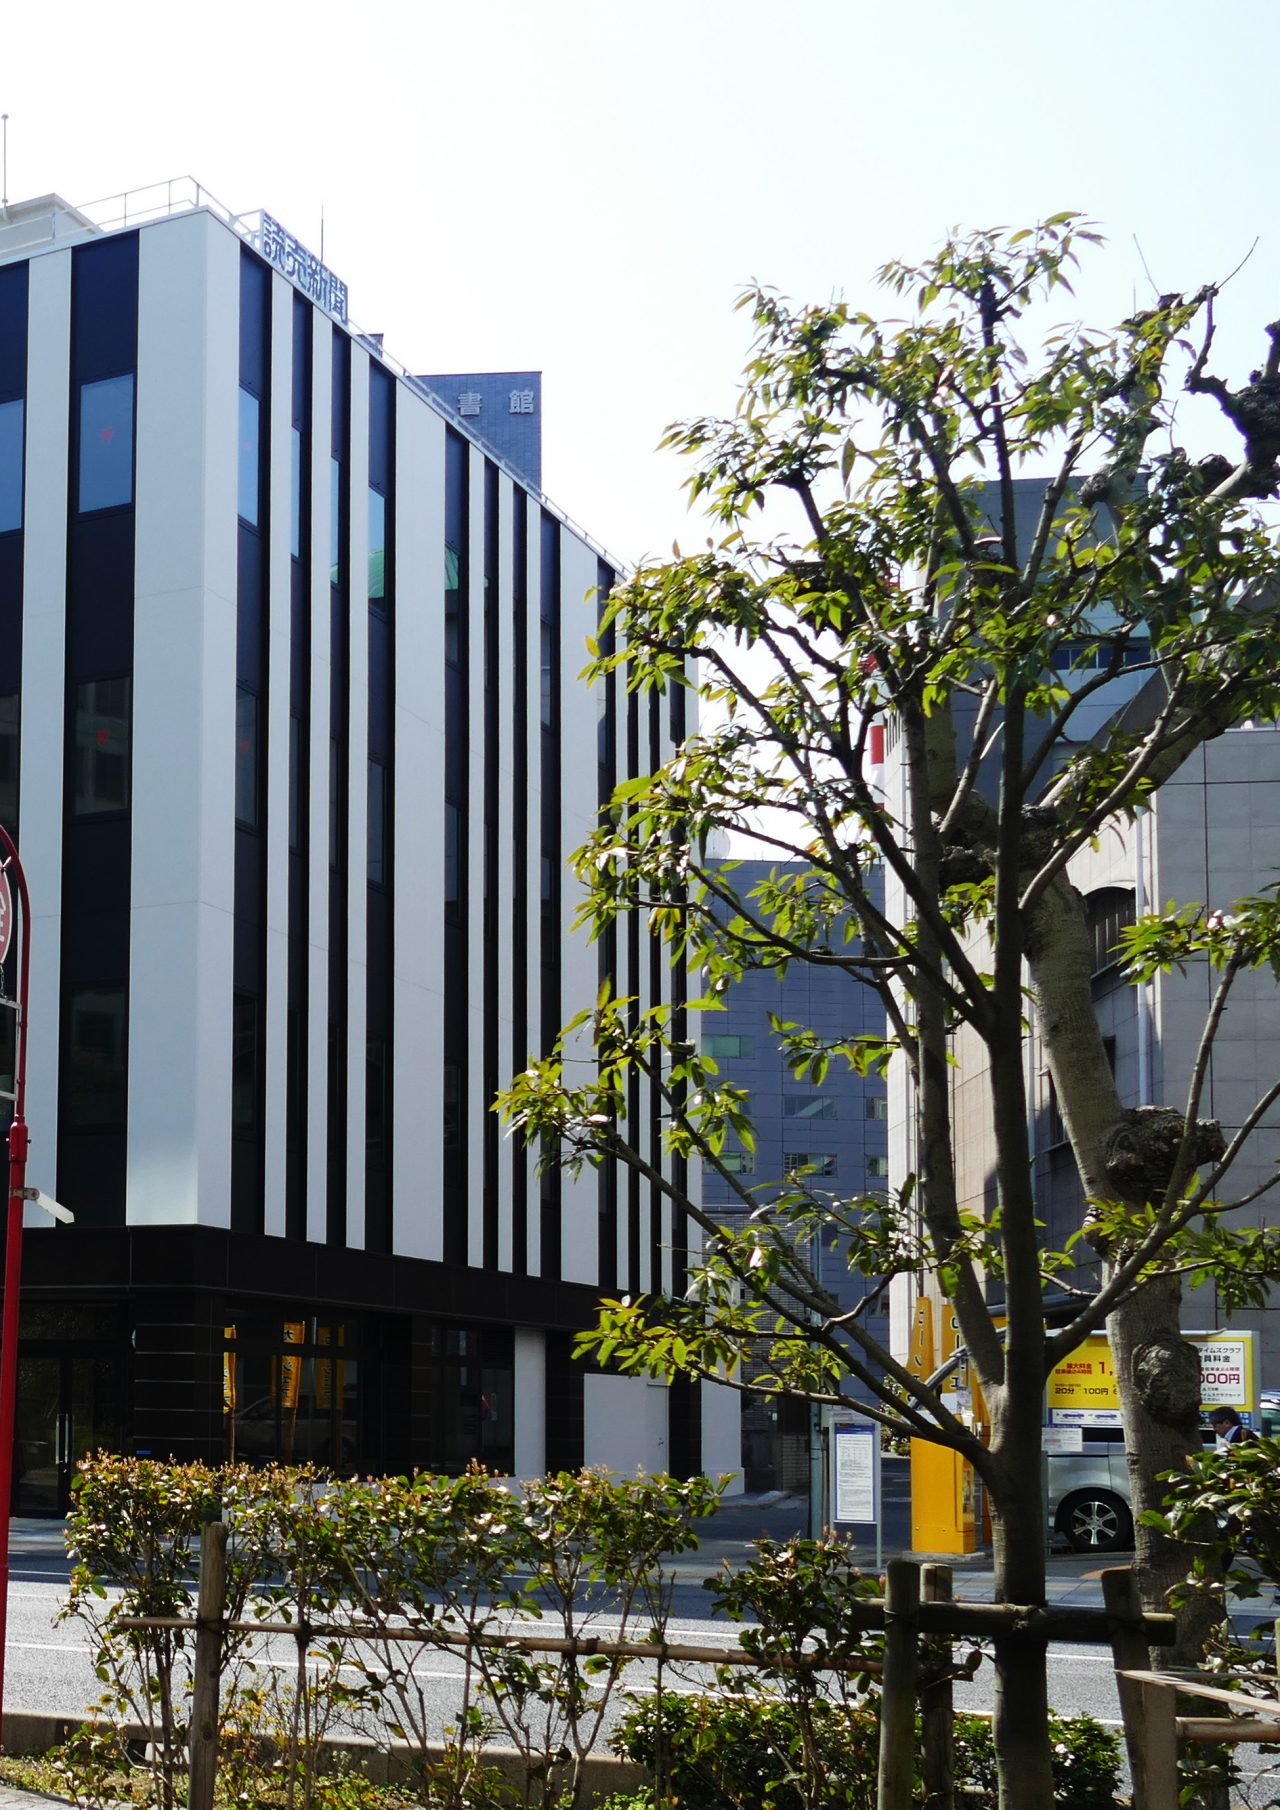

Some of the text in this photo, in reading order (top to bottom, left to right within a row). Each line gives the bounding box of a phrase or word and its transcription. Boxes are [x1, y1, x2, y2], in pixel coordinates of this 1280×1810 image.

[263, 212, 348, 326] 読売新聞
[1200, 1355, 1231, 1363] 員料金
